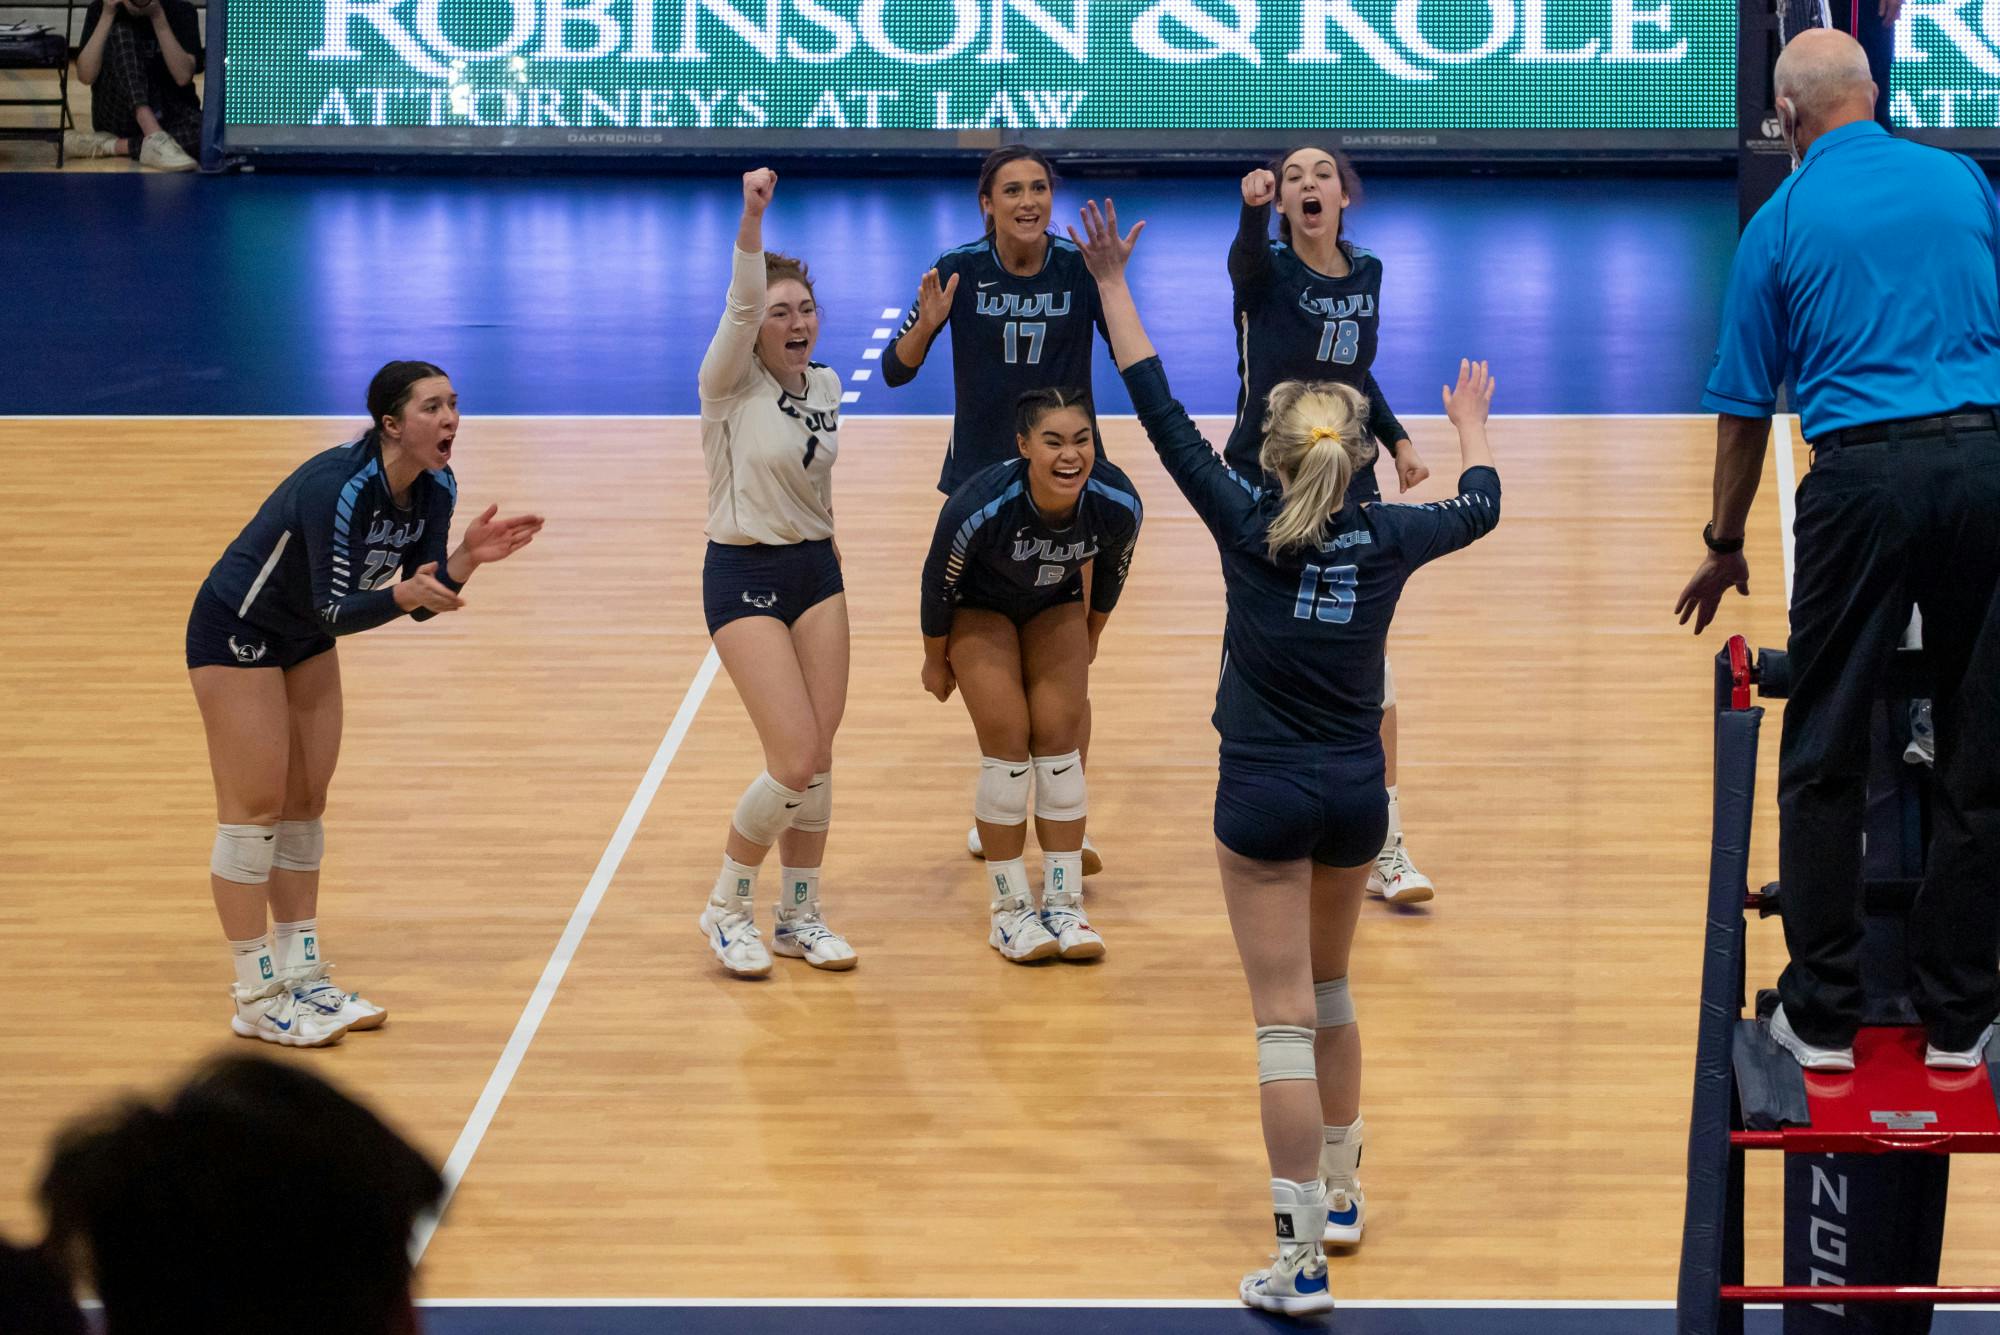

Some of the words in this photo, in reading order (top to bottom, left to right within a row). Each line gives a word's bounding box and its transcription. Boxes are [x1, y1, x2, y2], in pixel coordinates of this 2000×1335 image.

[308, 0, 1089, 78] ROBINSON
[1131, 0, 1260, 67] &
[312, 87, 766, 128] ATTORNEYS
[803, 90, 899, 129] AT
[932, 90, 1088, 129] LAW
[567, 133, 664, 144] DAKTRONICS
[1341, 135, 1438, 145] DAKTRONICS
[976, 291, 1072, 318] WWU
[1003, 321, 1047, 364] 17
[1316, 320, 1360, 366] 18
[1293, 563, 1359, 624] 13
